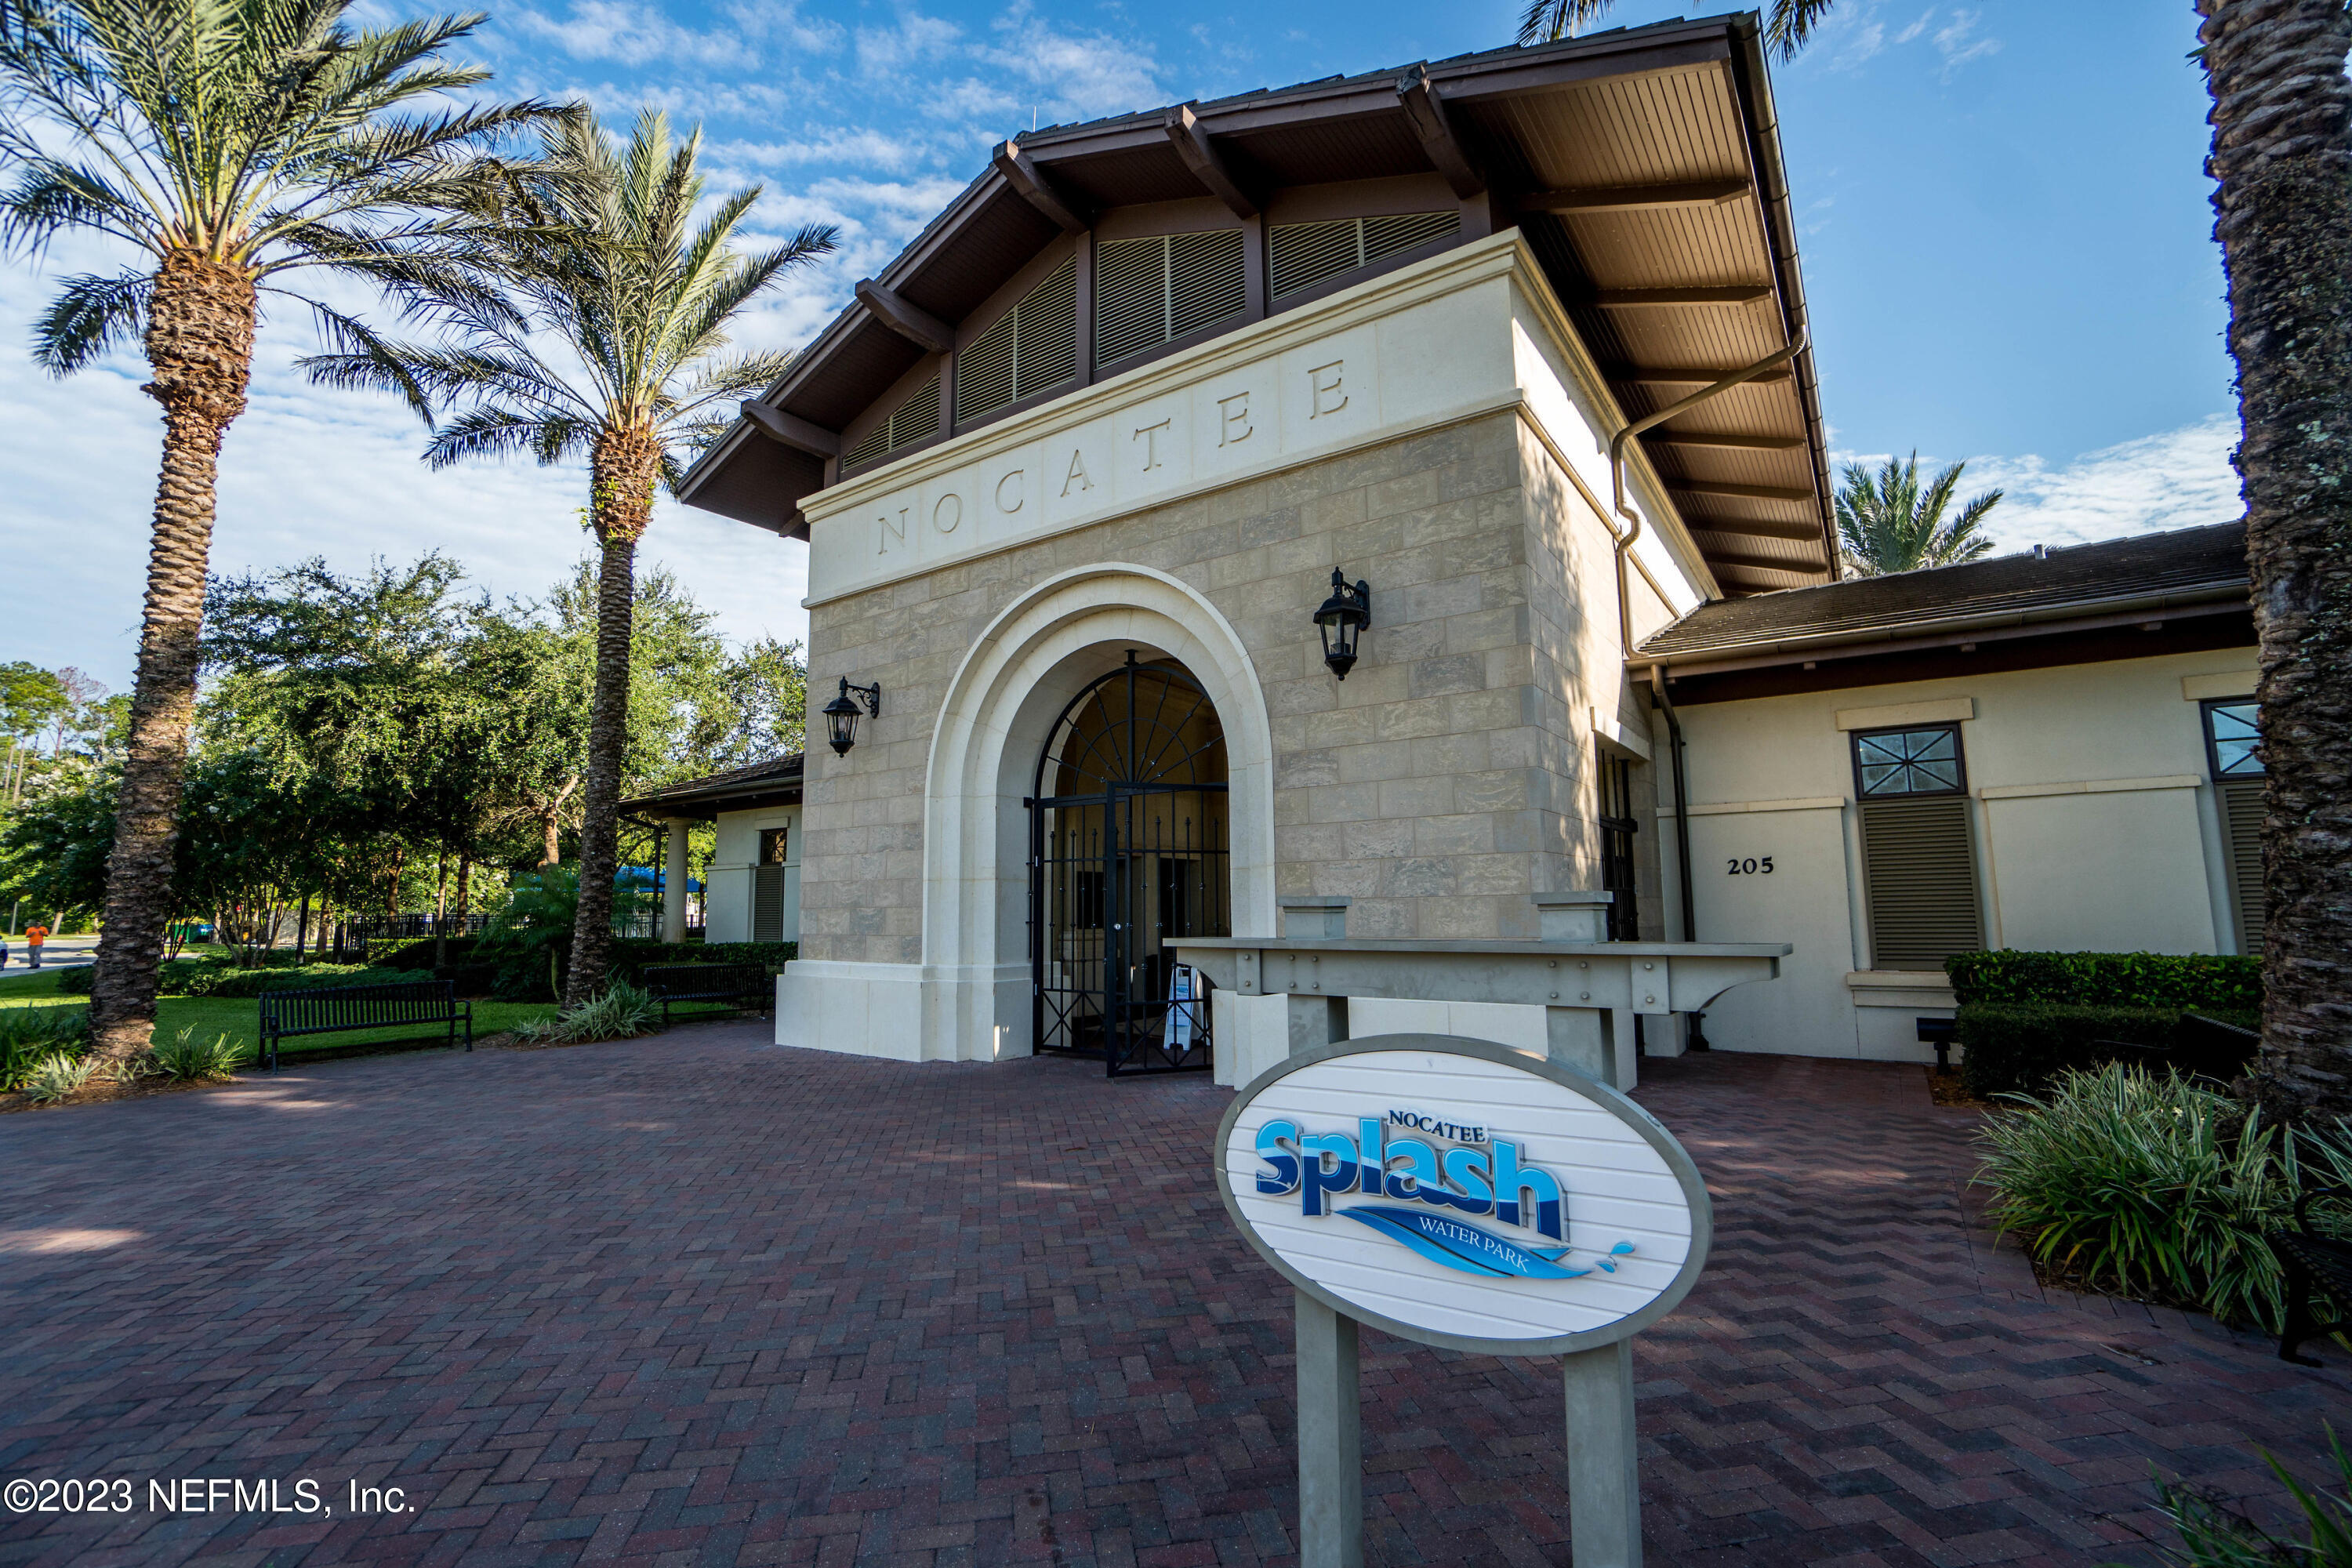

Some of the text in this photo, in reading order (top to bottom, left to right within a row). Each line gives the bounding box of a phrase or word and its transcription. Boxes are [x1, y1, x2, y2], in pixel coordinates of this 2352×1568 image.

[878, 360, 1348, 555] NOCATEE
[1727, 855, 1773, 875] 205
[1388, 1109, 1485, 1143] NOCATEE
[1419, 1216, 1529, 1273] WATER PARK
